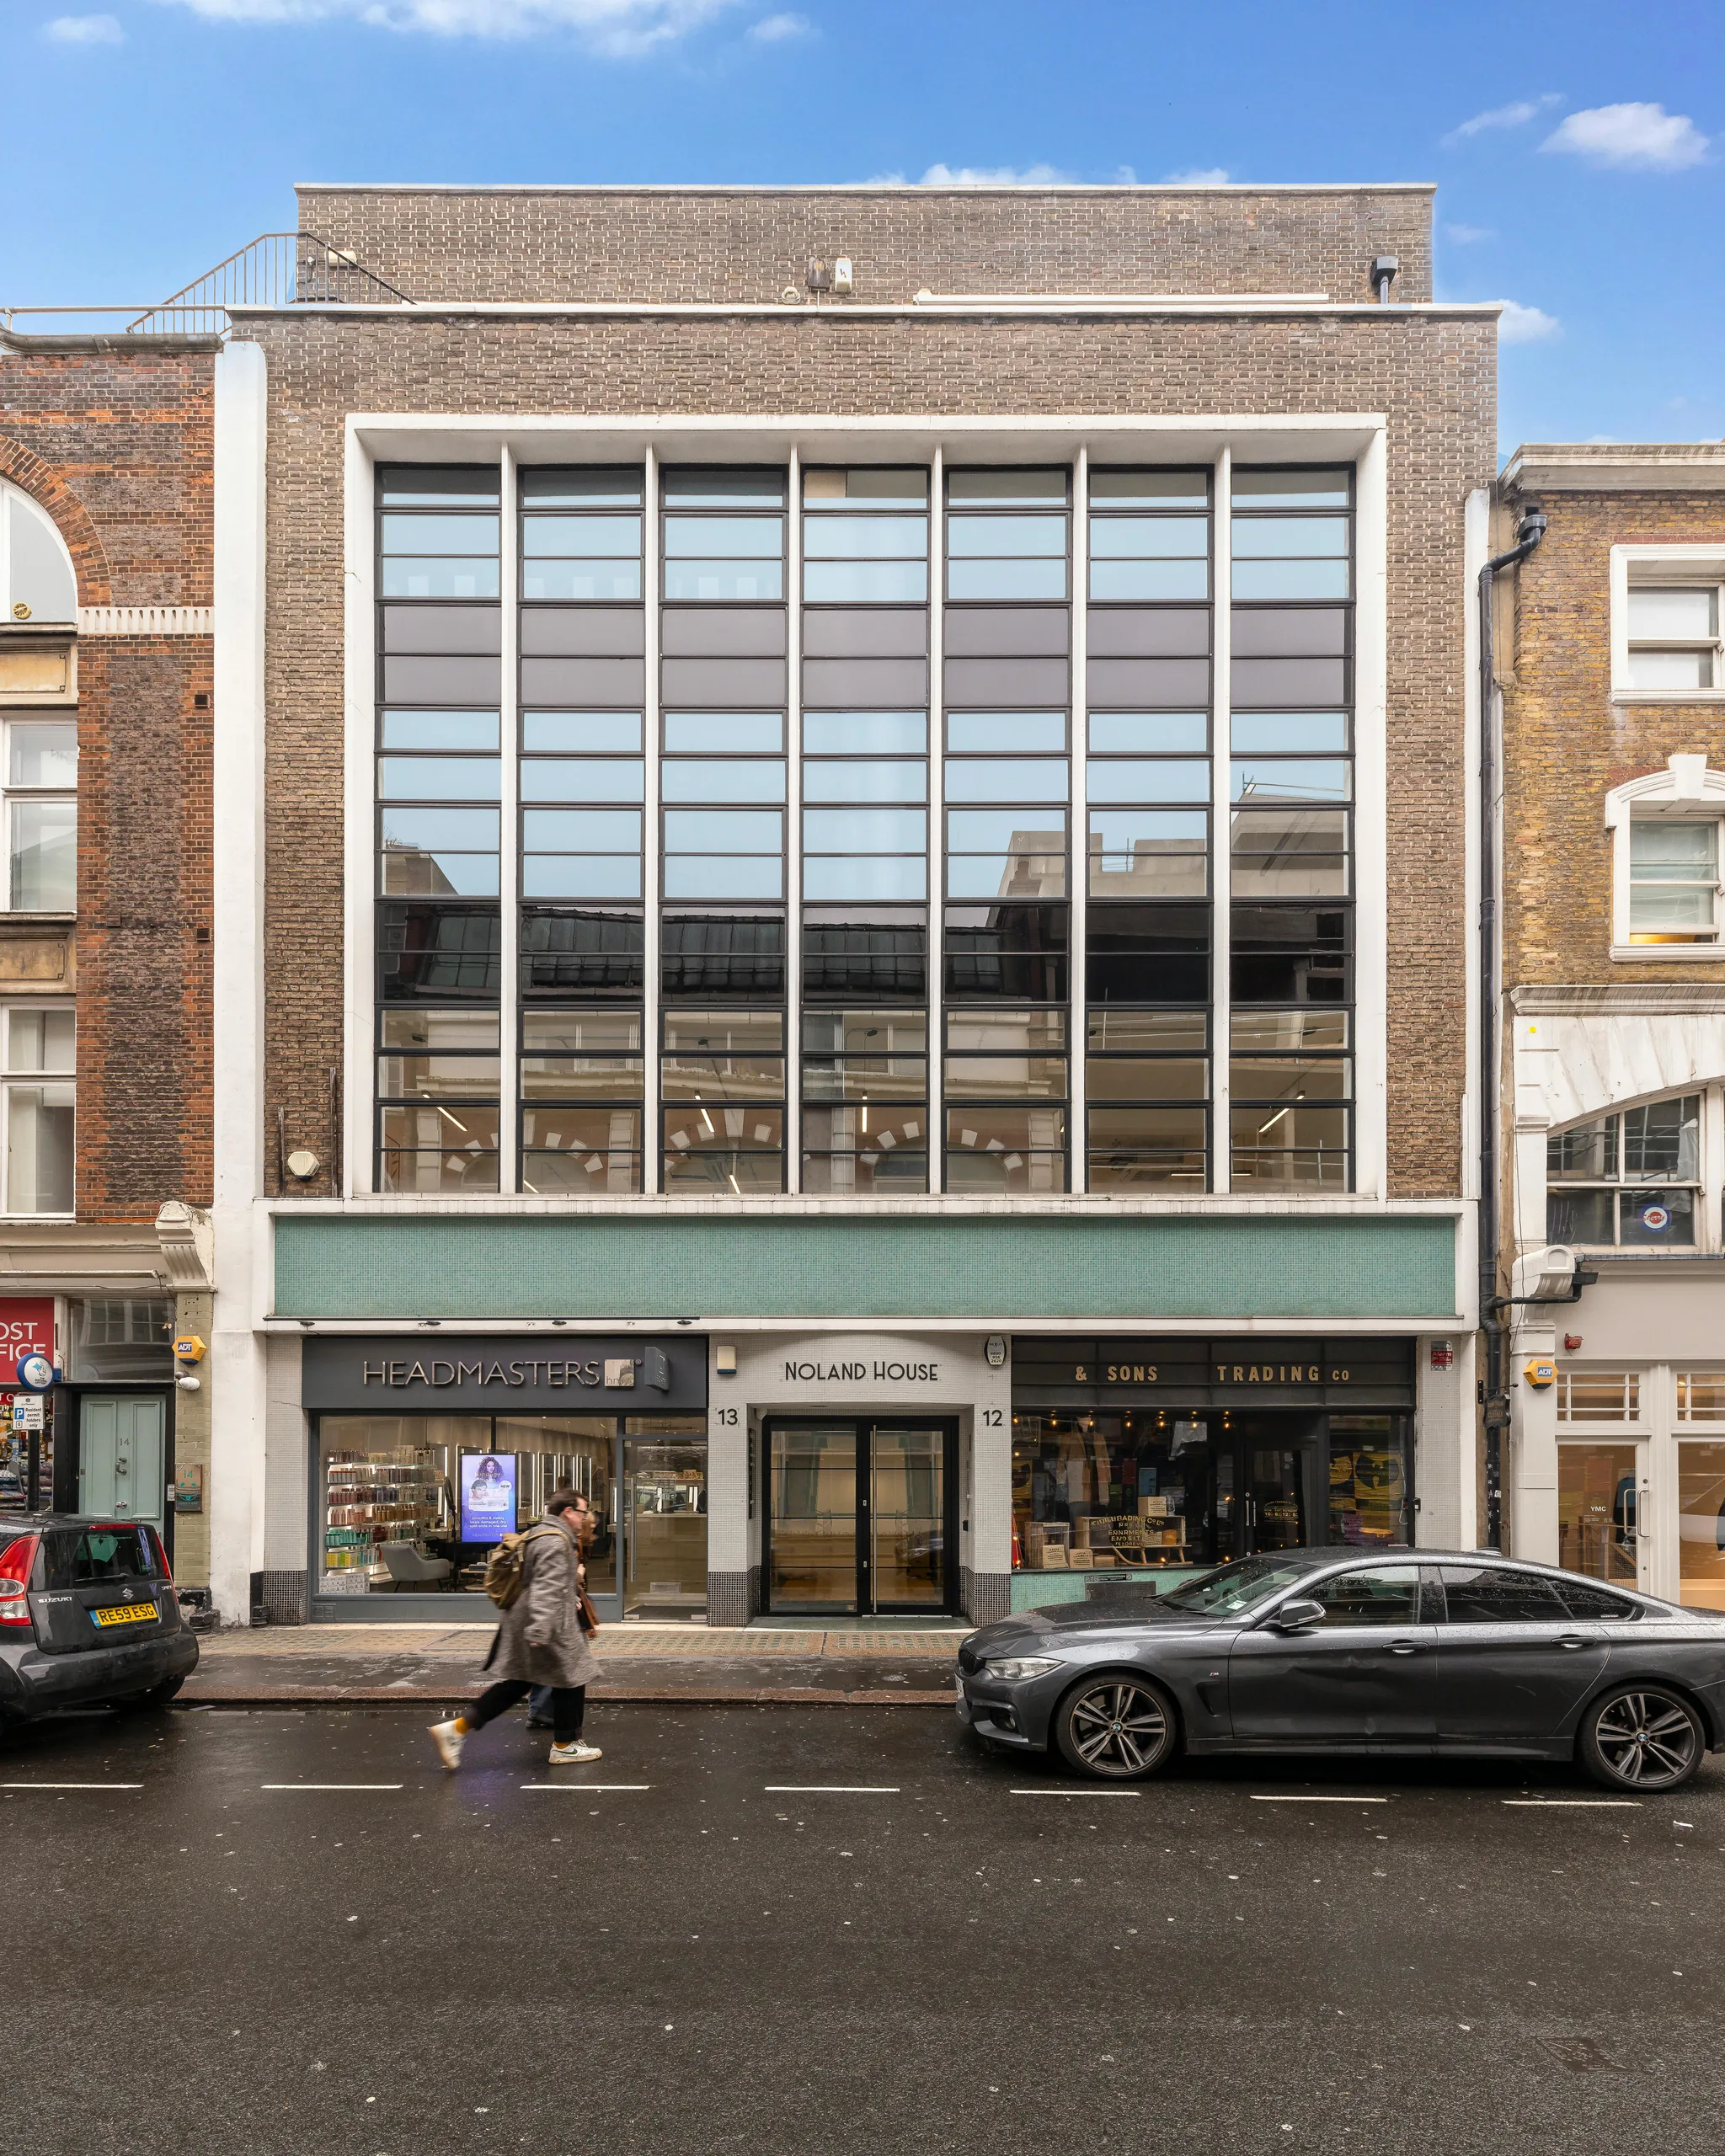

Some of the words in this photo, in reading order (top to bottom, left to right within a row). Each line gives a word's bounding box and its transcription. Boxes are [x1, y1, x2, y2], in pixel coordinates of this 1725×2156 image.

[363, 1360, 601, 1385] HEADMASTERS
[785, 1361, 867, 1380] NOLAND
[873, 1361, 938, 1381] HOUSE
[1075, 1366, 1087, 1381] &
[1107, 1365, 1158, 1381] SONS
[1217, 1365, 1319, 1381] TRADING
[17, 1409, 24, 1419] P
[718, 1408, 739, 1426] 13
[982, 1409, 1003, 1427] 12
[120, 1438, 131, 1446] 14
[183, 1469, 194, 1479] 14
[99, 1609, 132, 1624] RE59
[133, 1605, 155, 1619] ESG
